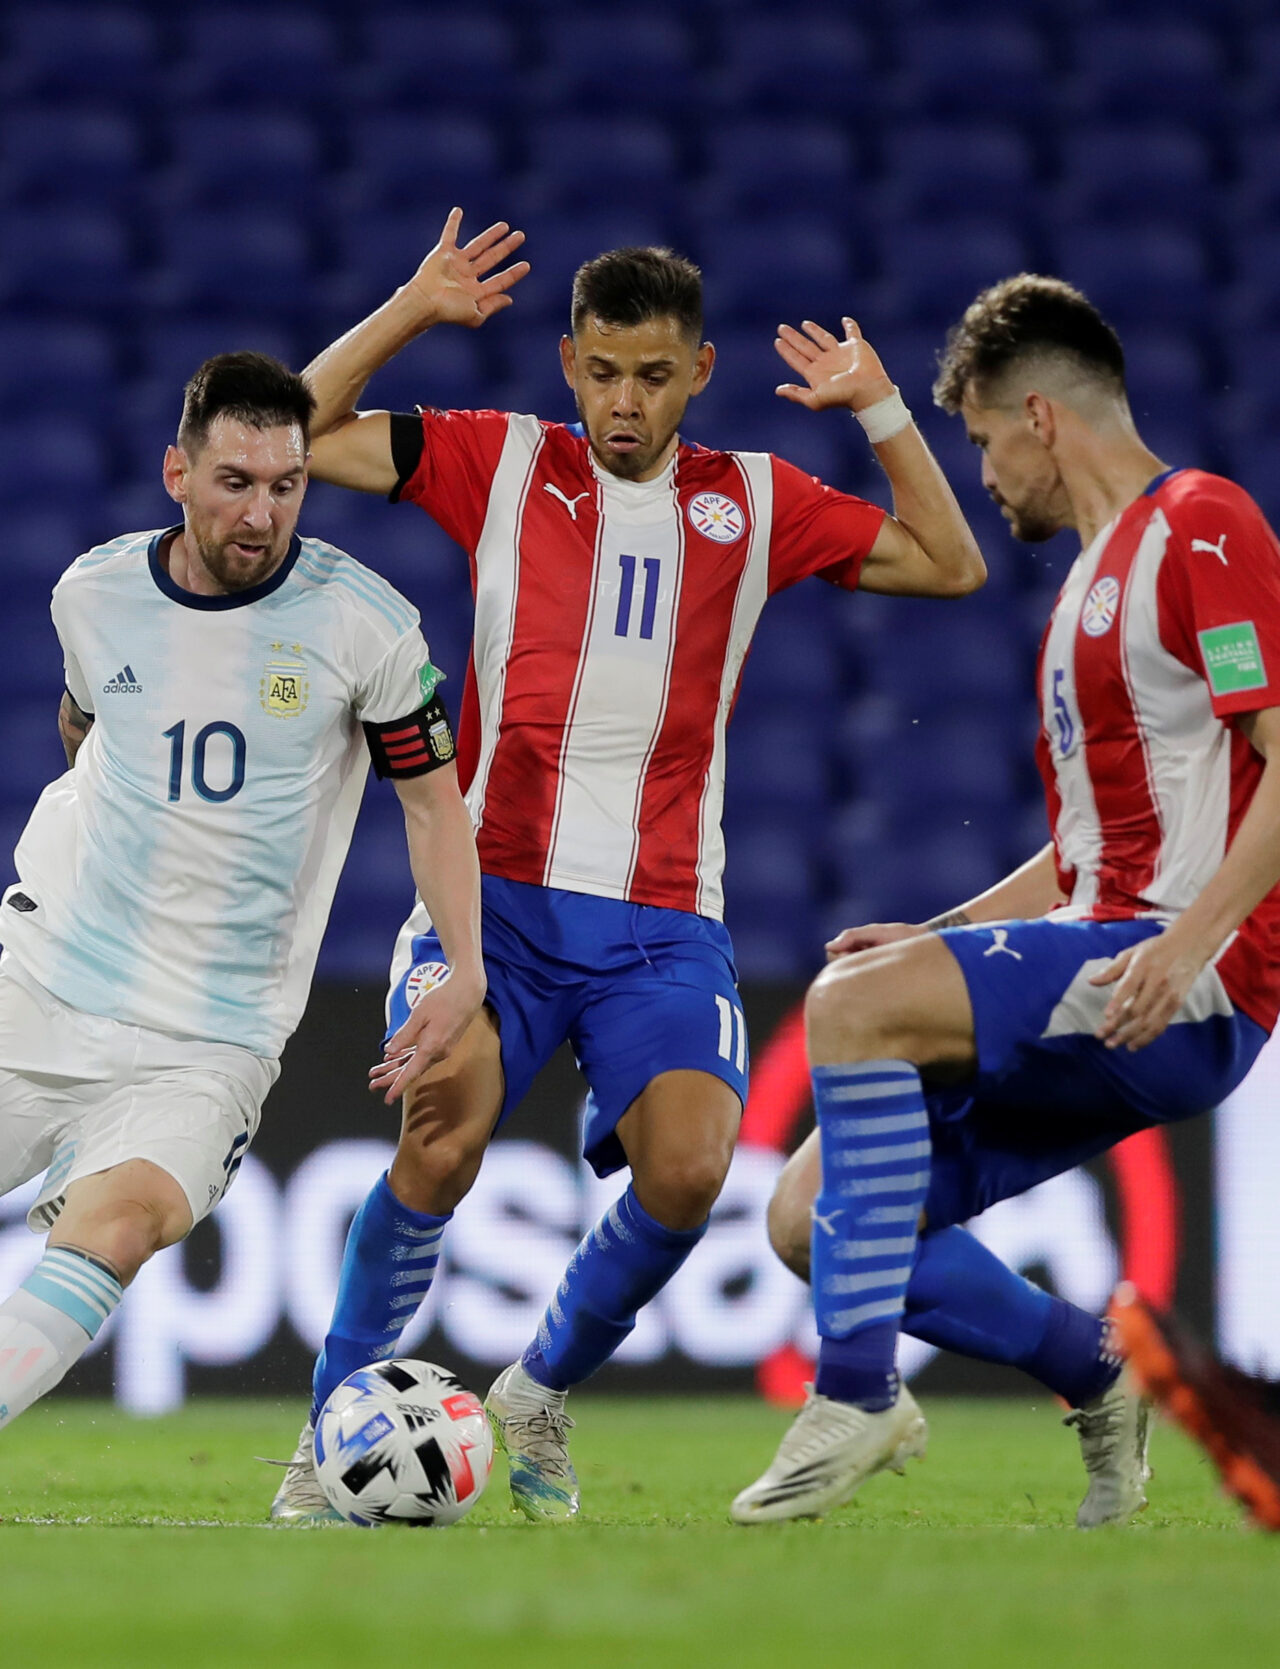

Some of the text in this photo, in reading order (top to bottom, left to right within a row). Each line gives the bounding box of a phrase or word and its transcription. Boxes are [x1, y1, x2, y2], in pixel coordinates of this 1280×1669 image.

[703, 496, 720, 505] APF
[614, 554, 661, 641] 11
[103, 682, 143, 694] adidas
[270, 675, 298, 703] AFA
[1052, 668, 1074, 754] 5
[161, 718, 247, 804] 10
[416, 964, 435, 977] APF
[714, 993, 745, 1075] 11
